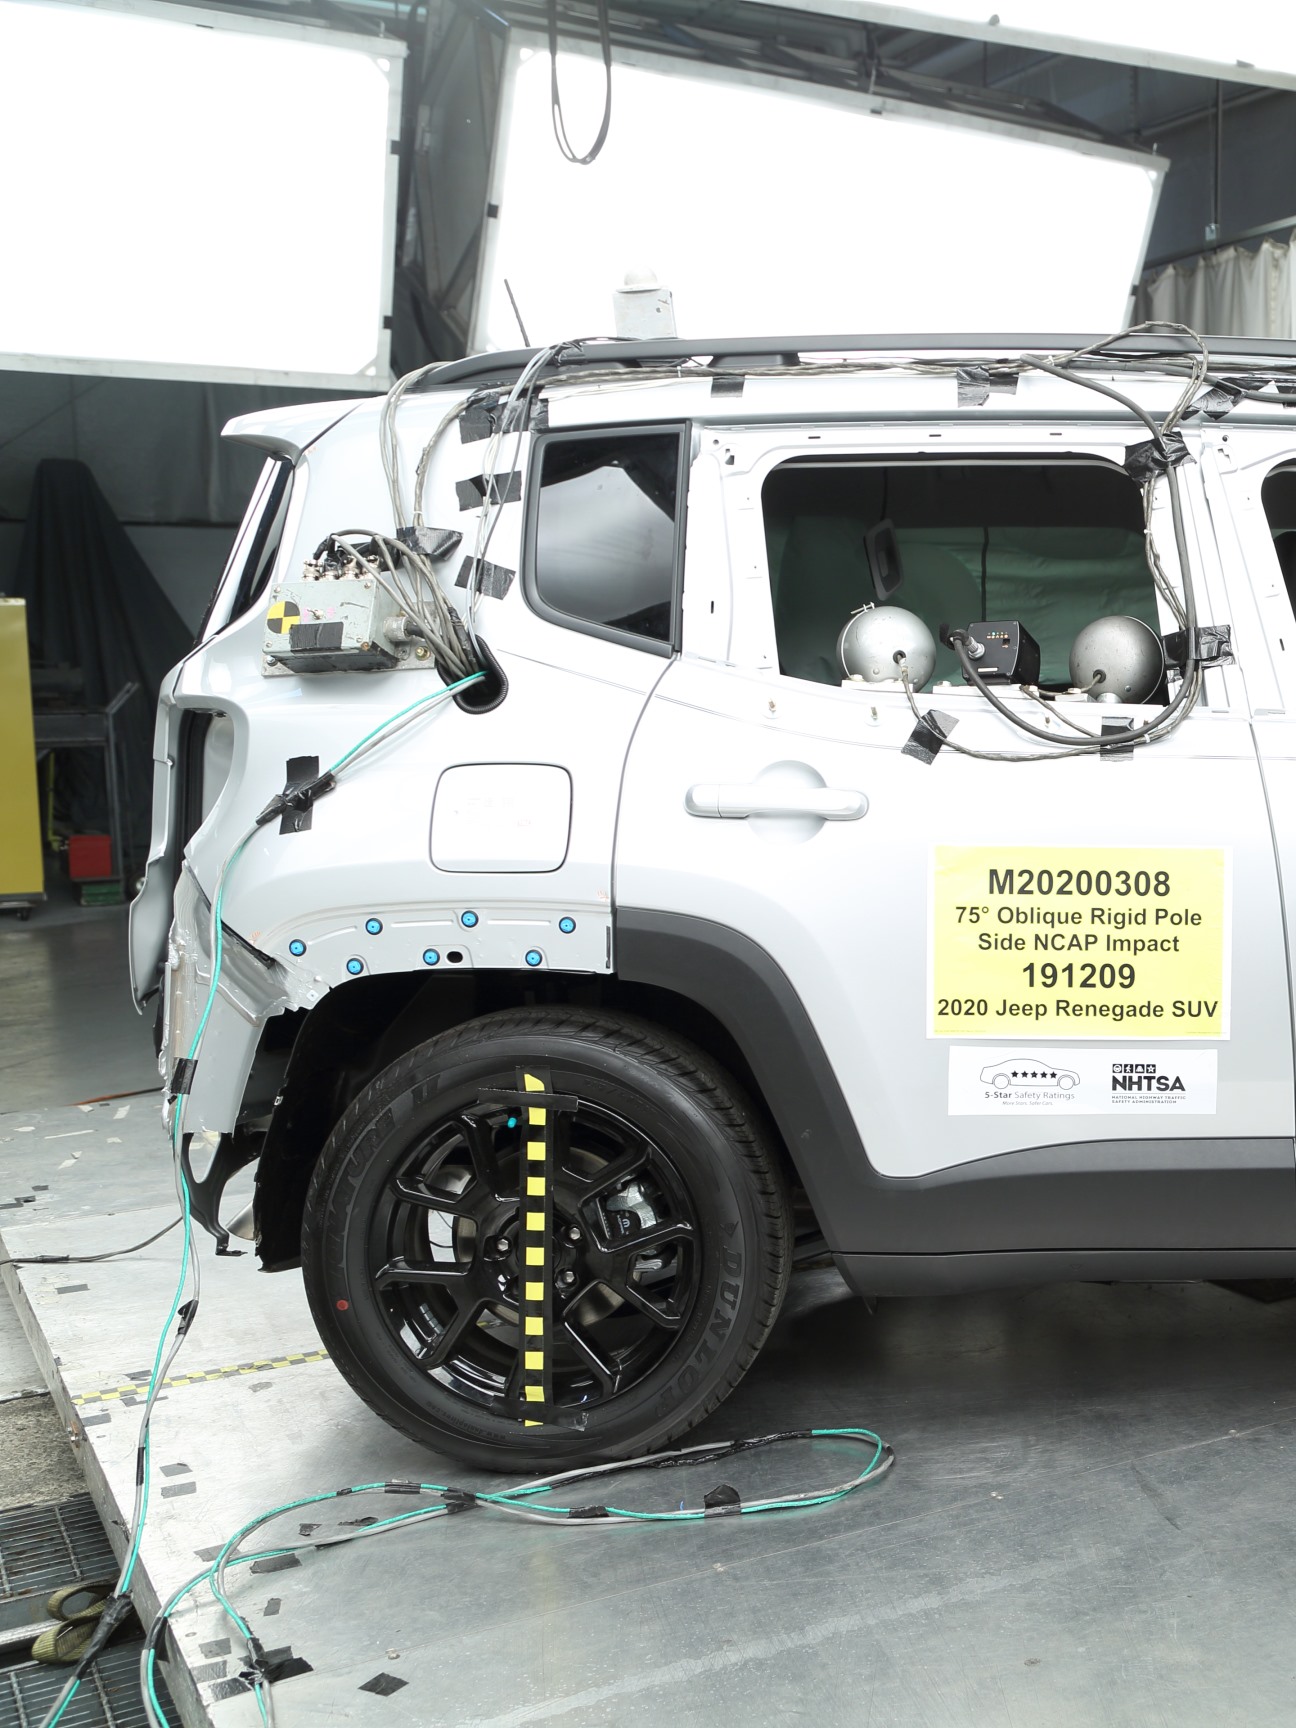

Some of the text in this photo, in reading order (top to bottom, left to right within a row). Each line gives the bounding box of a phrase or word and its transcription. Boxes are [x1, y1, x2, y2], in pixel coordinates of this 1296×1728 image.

[988, 869, 1170, 896] M20200308
[956, 907, 1201, 929] 75° Oblique Rigid Pole
[979, 933, 1179, 956] Side NCAP Impact
[1023, 963, 1135, 988] 191209
[938, 999, 1218, 1021] 2020 Jeep Renegade SUV
[1112, 1075, 1186, 1092] NHTSA
[984, 1091, 1075, 1101] 5-Star Safety Ratings
